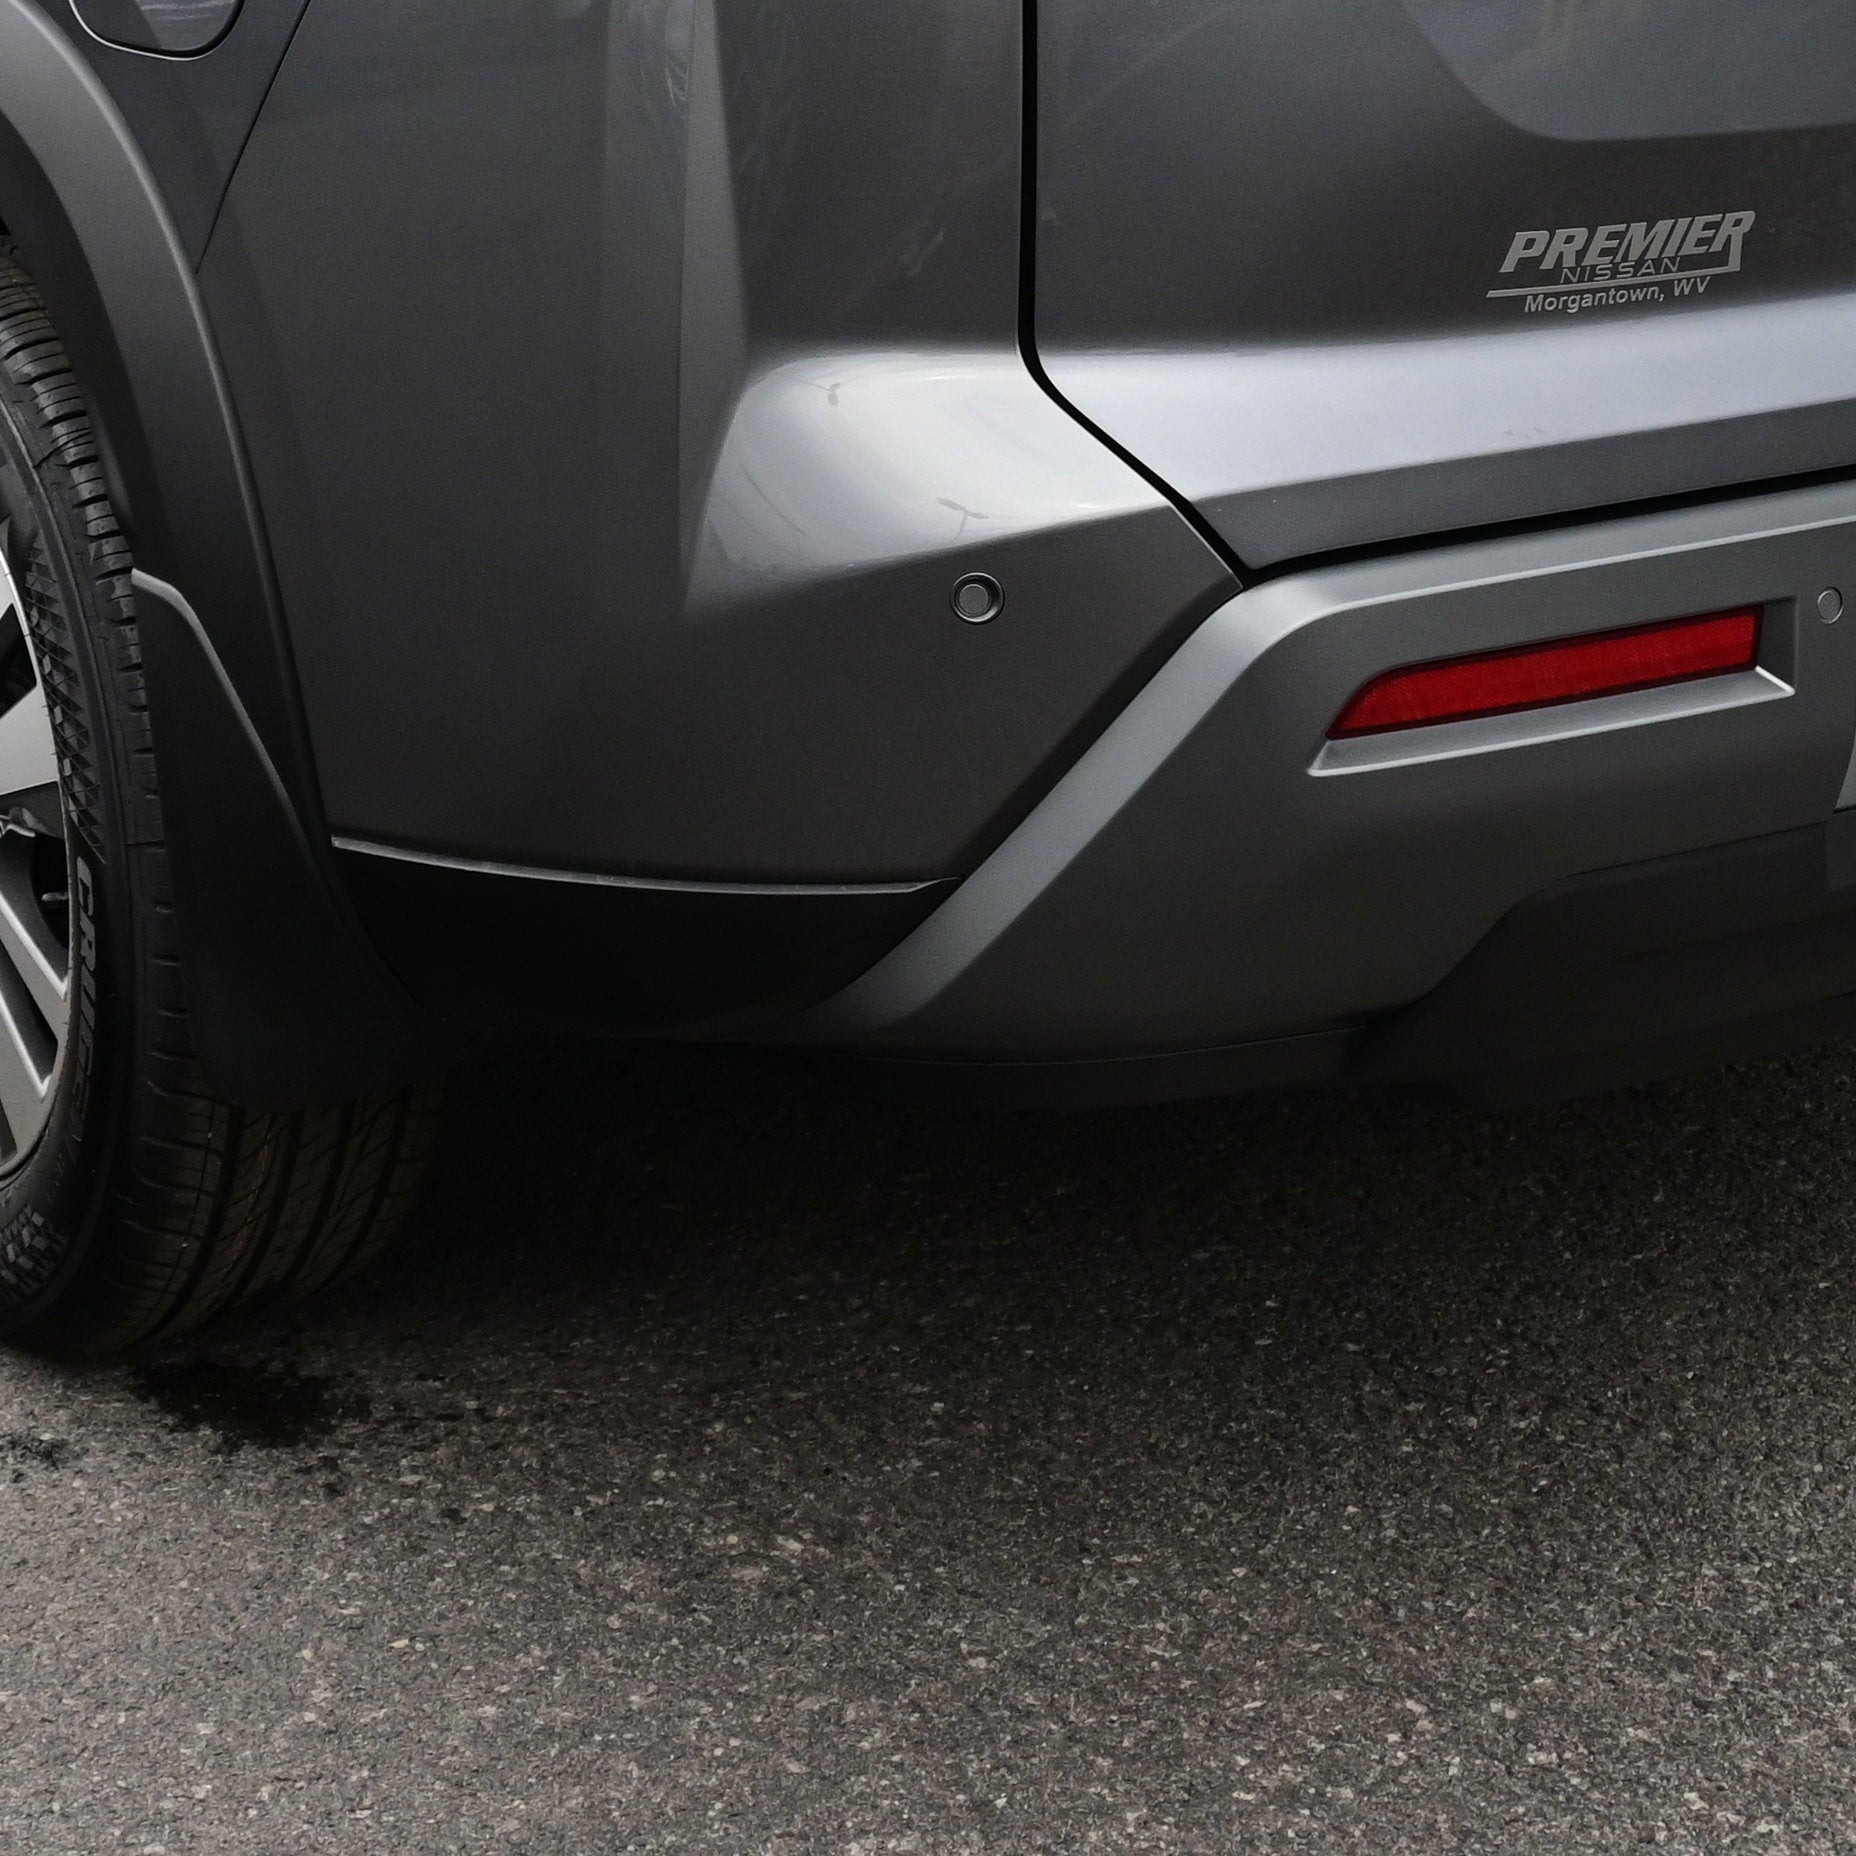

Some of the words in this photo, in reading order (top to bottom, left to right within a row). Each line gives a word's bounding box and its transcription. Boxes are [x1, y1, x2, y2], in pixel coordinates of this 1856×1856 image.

[1498, 210, 1756, 273] PREMIER
[1559, 256, 1681, 285] NISSAN
[1524, 286, 1665, 314] Morgantown,
[1673, 275, 1711, 297] WV
